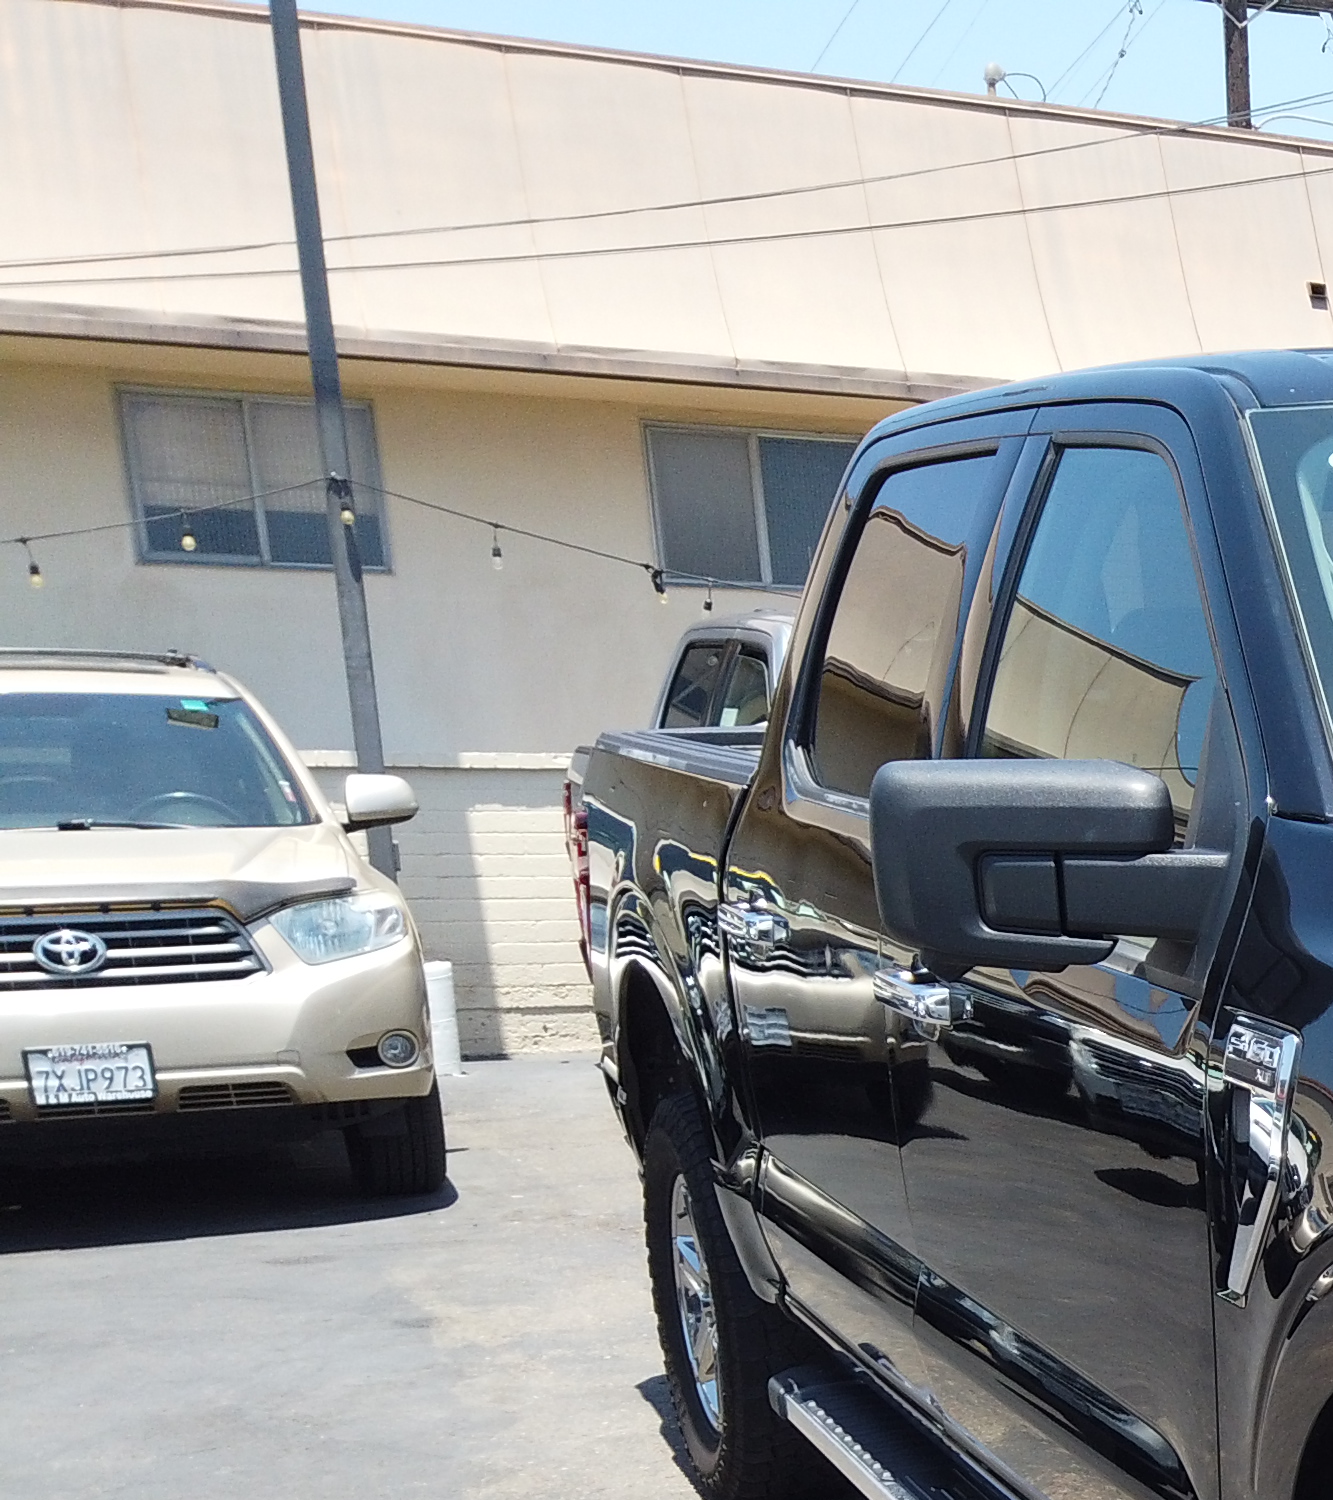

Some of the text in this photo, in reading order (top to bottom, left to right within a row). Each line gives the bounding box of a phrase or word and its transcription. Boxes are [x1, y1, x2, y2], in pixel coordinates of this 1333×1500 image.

[36, 1065, 147, 1093] 7XJP973
[70, 1092, 96, 1102] Auto
[98, 1089, 153, 1101] Warehouse
